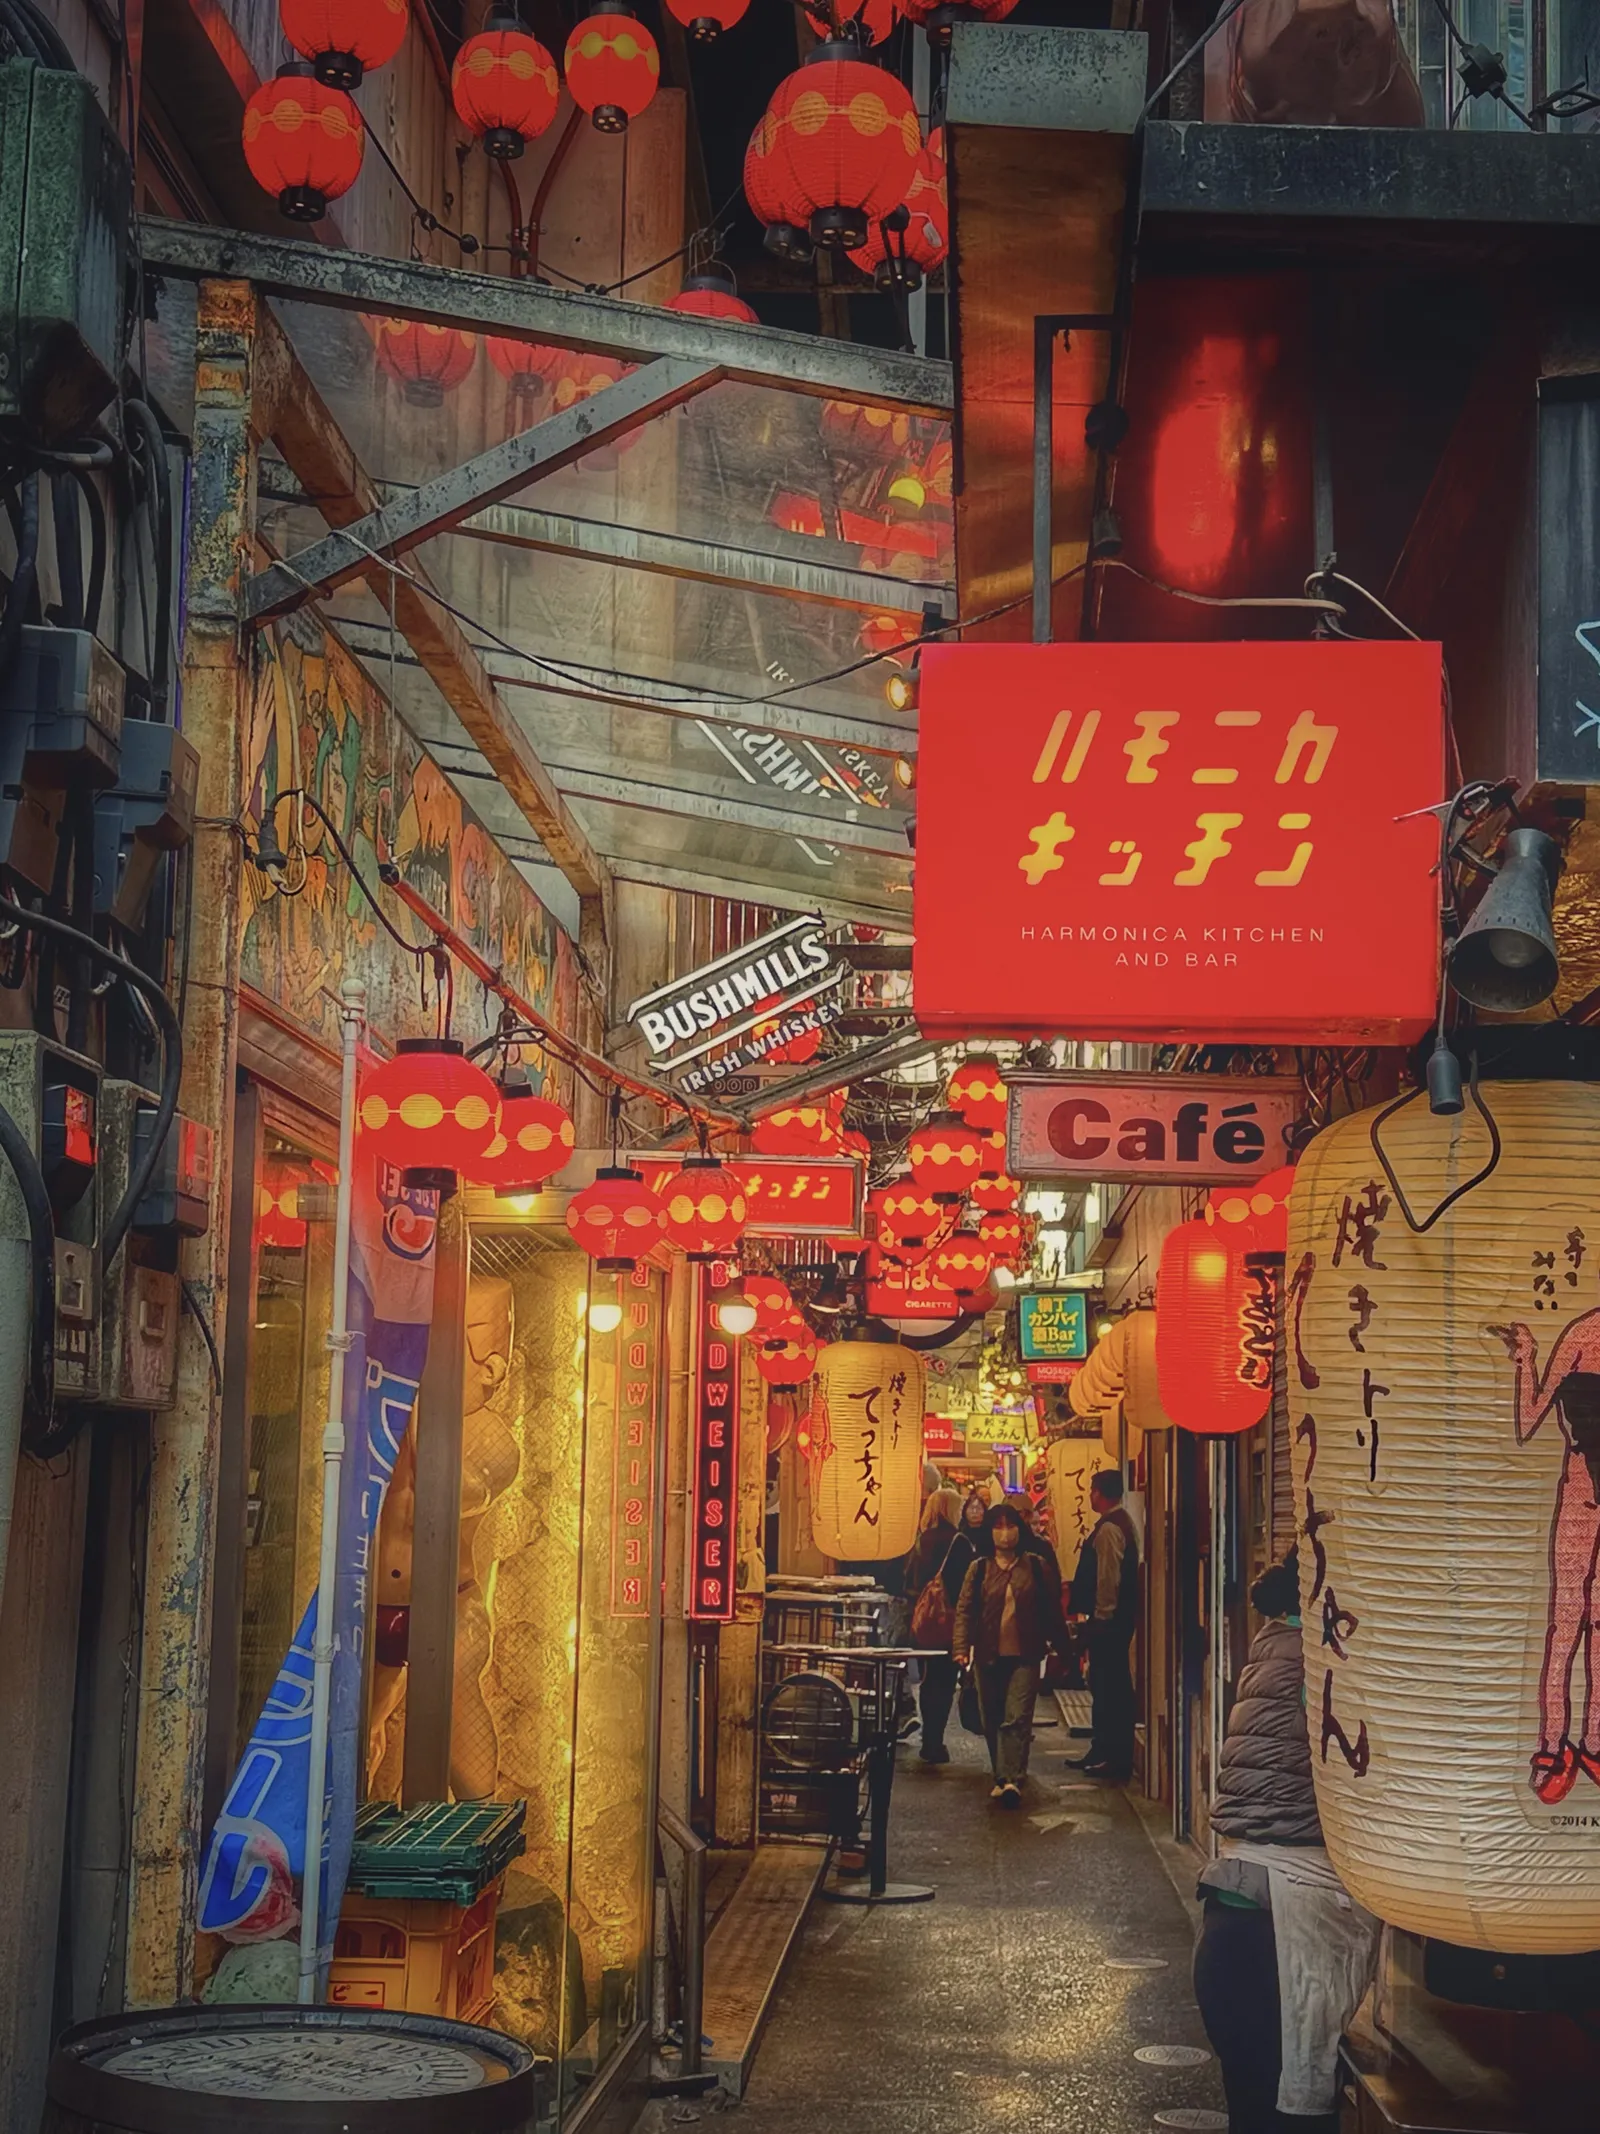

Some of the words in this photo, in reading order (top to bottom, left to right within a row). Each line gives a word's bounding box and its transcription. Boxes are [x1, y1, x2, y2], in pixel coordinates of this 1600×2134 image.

[1032, 709, 1339, 784] ハモニカ
[1018, 811, 1314, 887] キッチン
[1021, 926, 1187, 942] HARMONICA
[1203, 927, 1325, 943] KITCHEN
[1115, 952, 1169, 968] AND
[1185, 952, 1239, 968] BAR
[637, 932, 830, 1055] BUSHMILLS
[681, 1051, 742, 1093] IRISH
[744, 997, 845, 1060] WHISKEY
[1047, 1098, 1266, 1165] Café
[904, 1300, 952, 1309] CIGARETTE
[848, 1385, 882, 1526] てっちゃん
[971, 1427, 1021, 1441] みんみん
